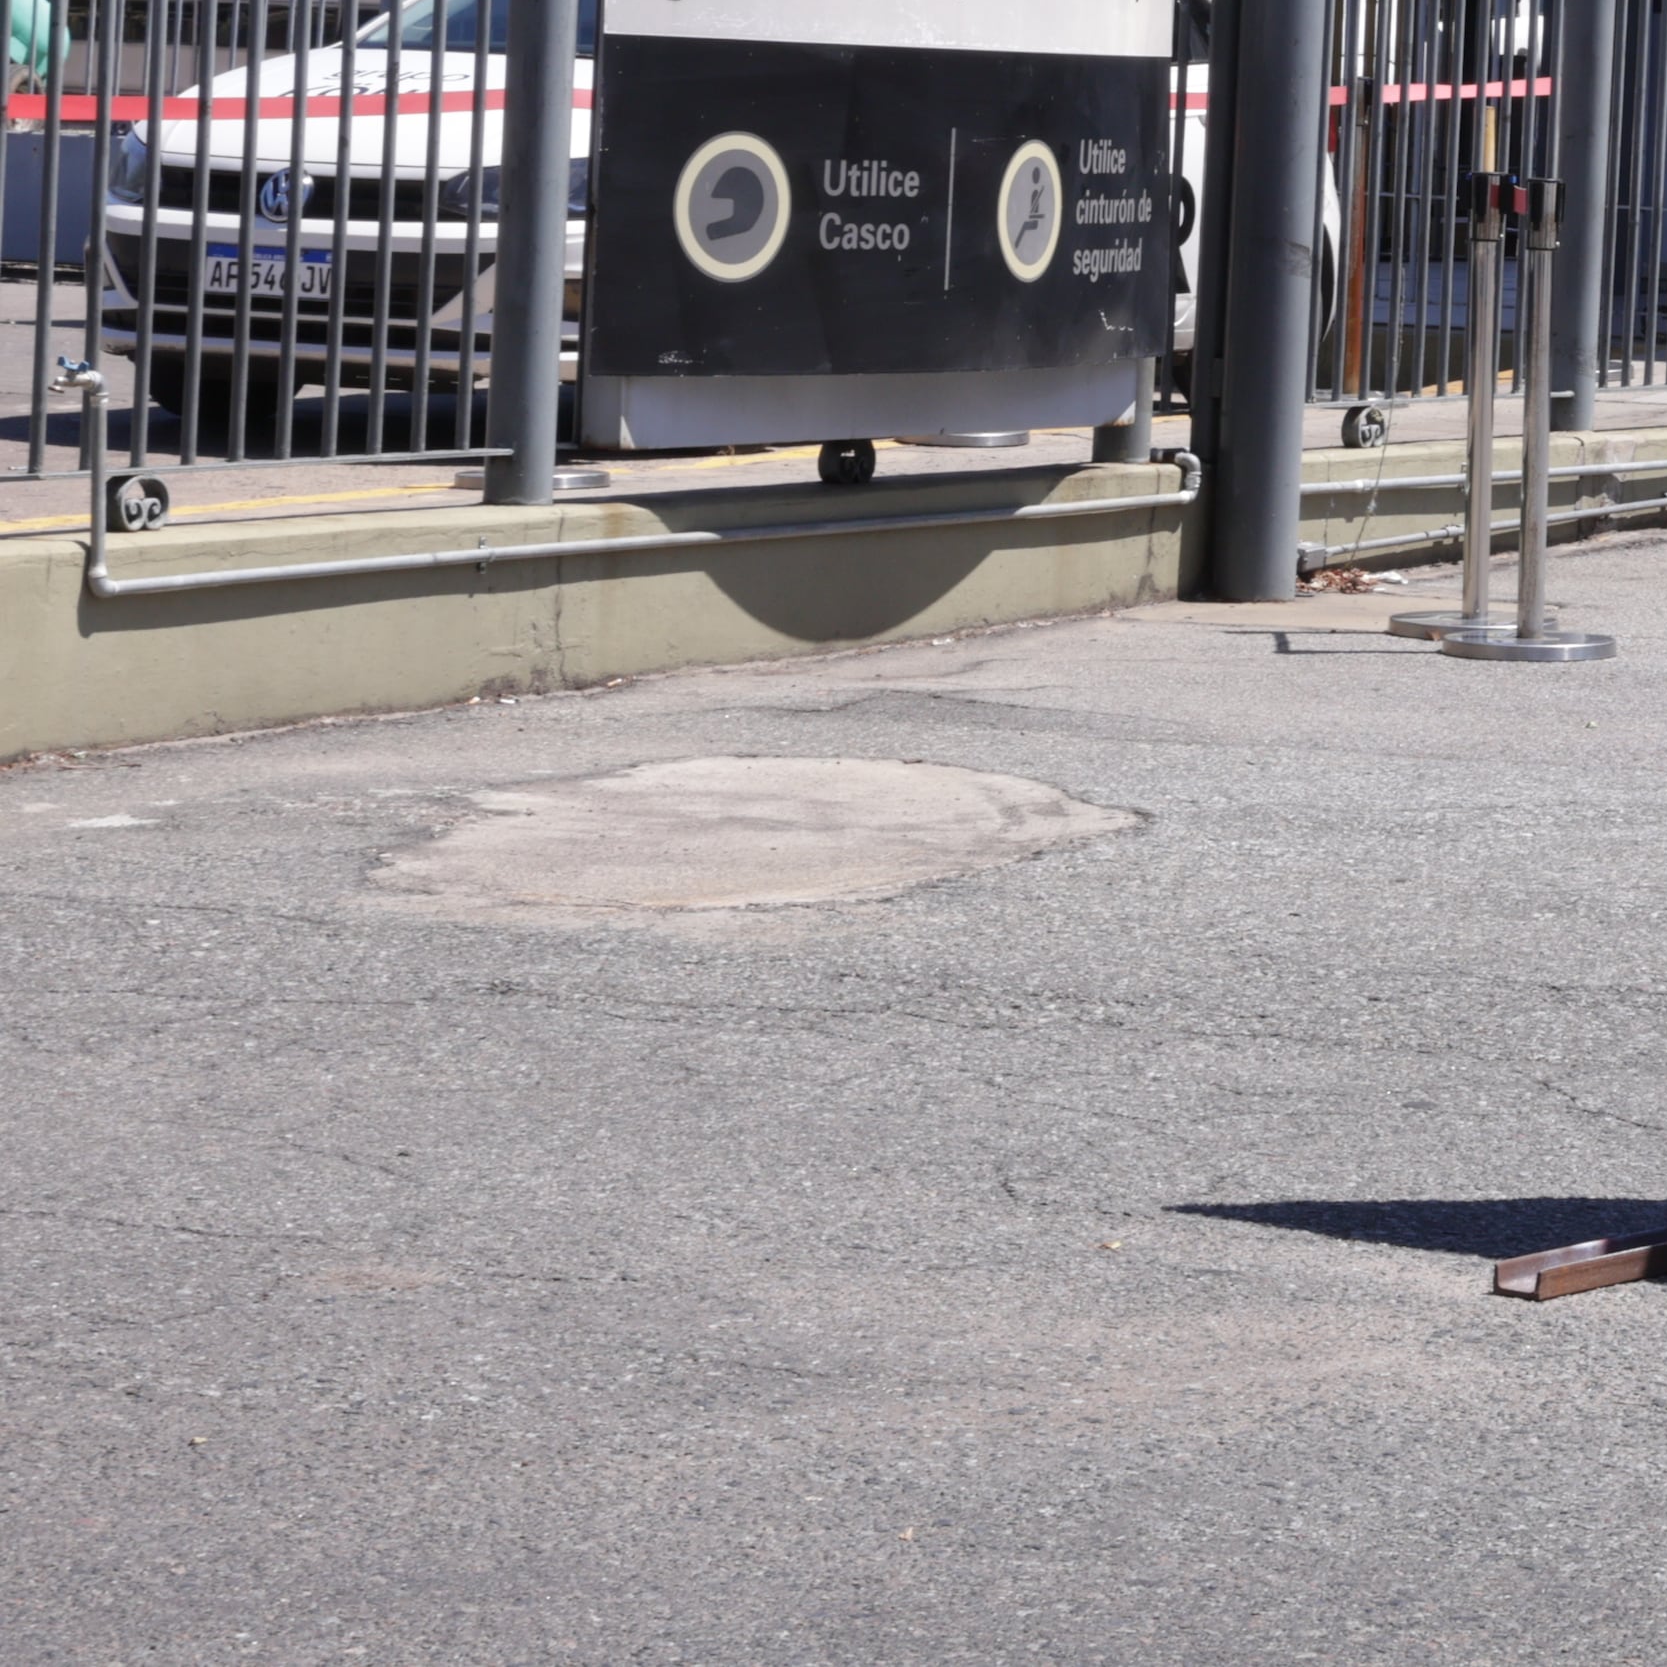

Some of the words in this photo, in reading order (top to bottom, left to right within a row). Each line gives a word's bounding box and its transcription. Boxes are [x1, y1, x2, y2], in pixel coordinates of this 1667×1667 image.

[1079, 138, 1127, 175] Utilice
[822, 160, 920, 199] Utilice
[1075, 188, 1135, 225] cinturón
[1137, 188, 1153, 223] de
[819, 212, 911, 251] Casco
[1072, 238, 1143, 283] seguridad
